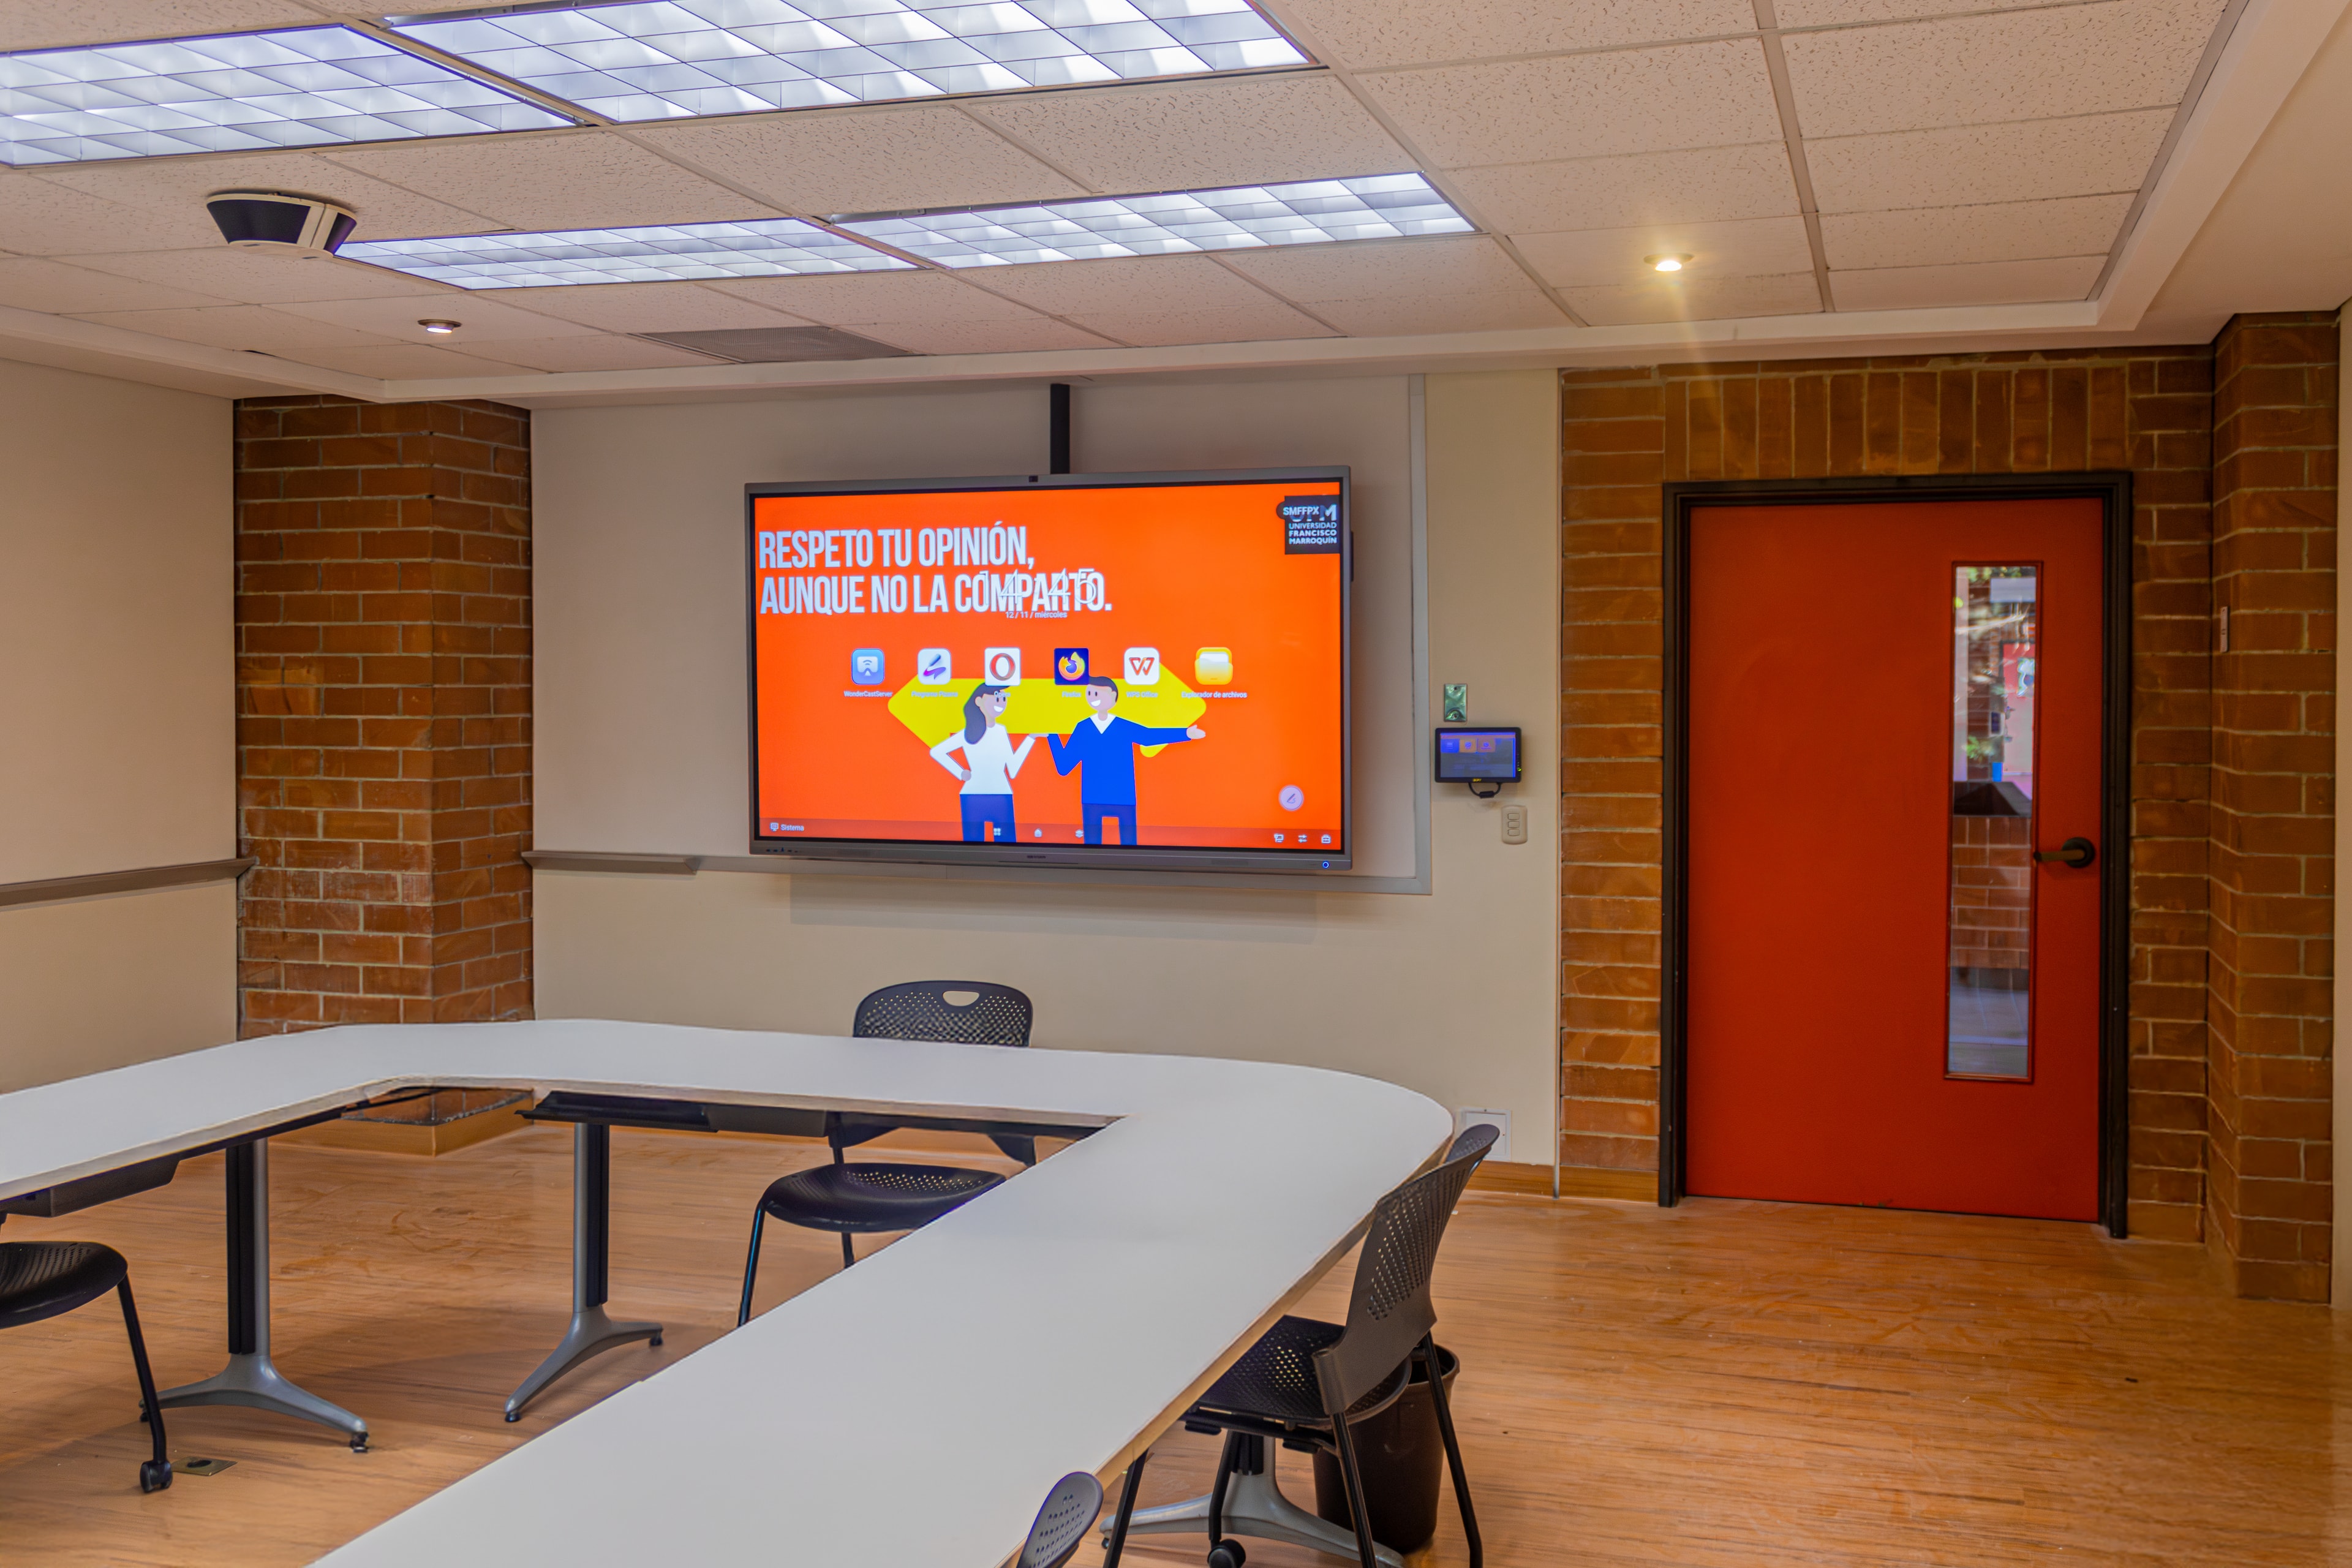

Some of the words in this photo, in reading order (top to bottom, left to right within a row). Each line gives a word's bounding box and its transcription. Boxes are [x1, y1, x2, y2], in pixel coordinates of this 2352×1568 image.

[1283, 505, 1320, 516] SMFFPX
[759, 529, 873, 569] RESPETO
[877, 528, 912, 568] TU
[918, 521, 1035, 570] OPINIÓN,
[1288, 536, 1337, 545] MARROQUÍN
[760, 575, 865, 616] AUNQUE
[870, 575, 908, 613] NO
[913, 575, 949, 613] LA
[954, 571, 1113, 612] COMPARTO.
